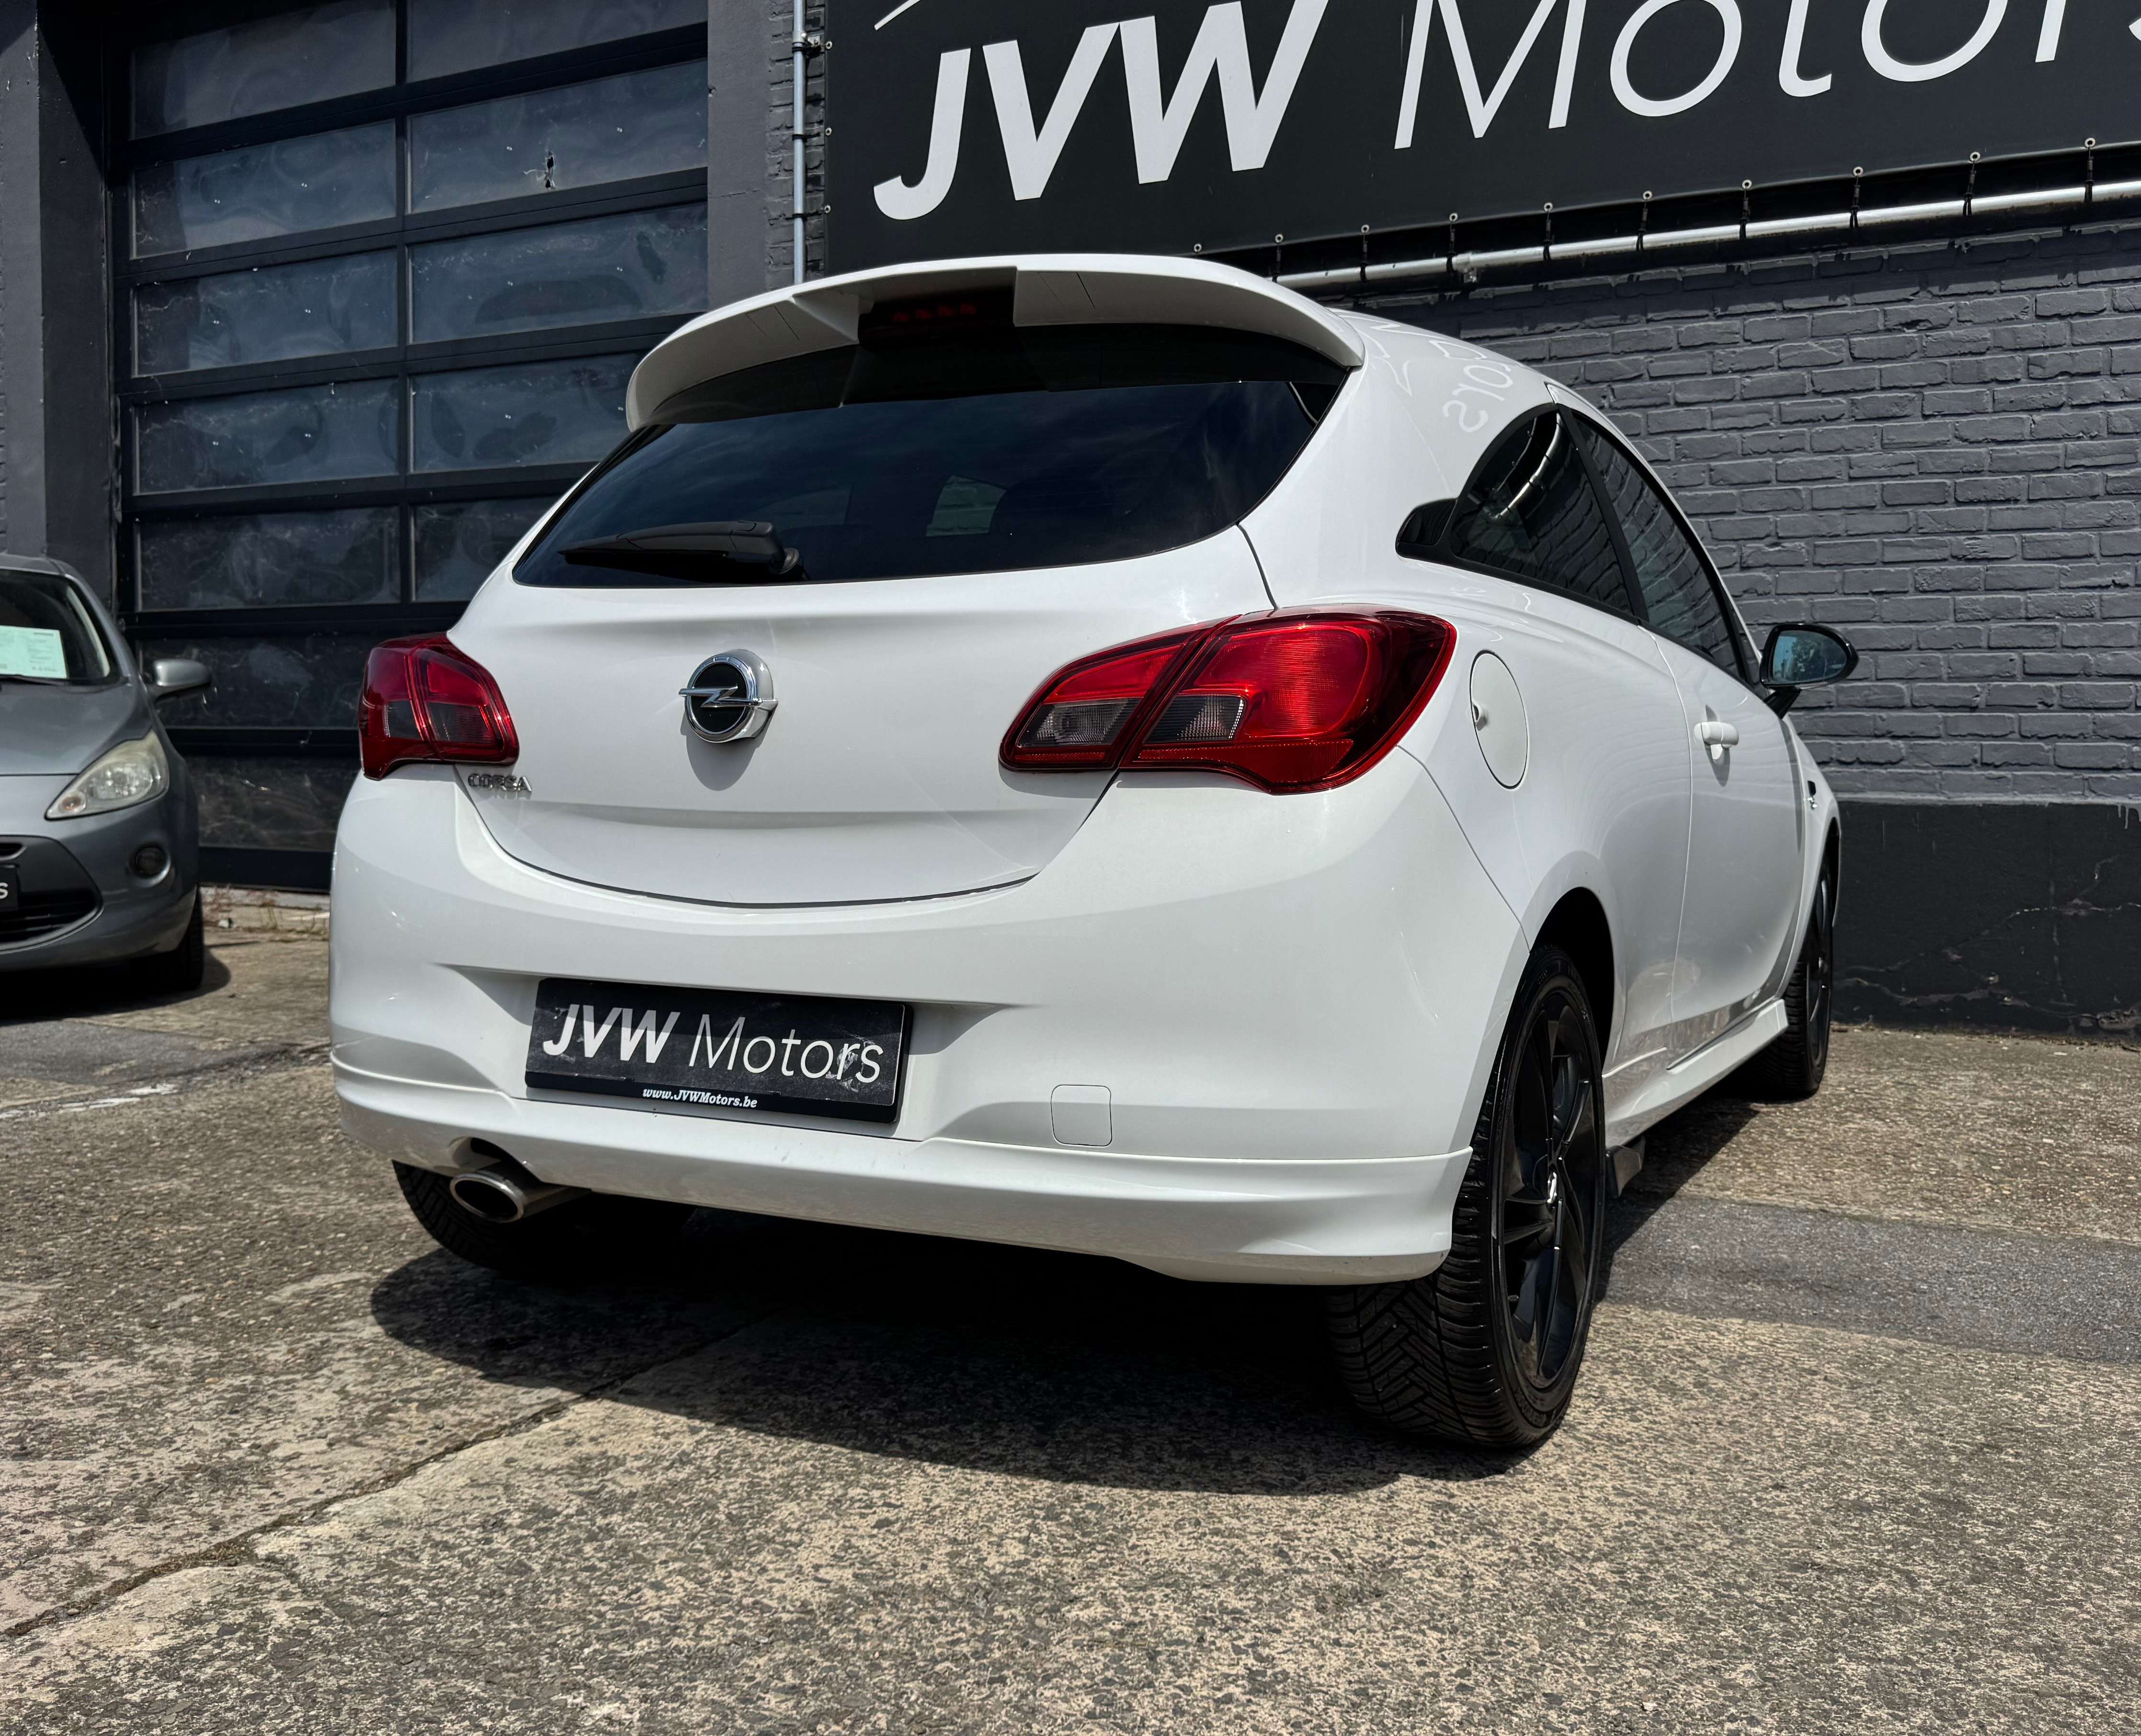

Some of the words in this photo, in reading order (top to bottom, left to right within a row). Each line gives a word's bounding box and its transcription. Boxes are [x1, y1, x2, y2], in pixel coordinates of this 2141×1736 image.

[874, 0, 1328, 219] JVW
[1395, 0, 2141, 149] Moto
[467, 773, 532, 792] CORSA
[543, 1004, 681, 1063] JVW
[689, 1014, 883, 1083] Motors
[643, 1089, 757, 1108] www.JVWMotors.be
